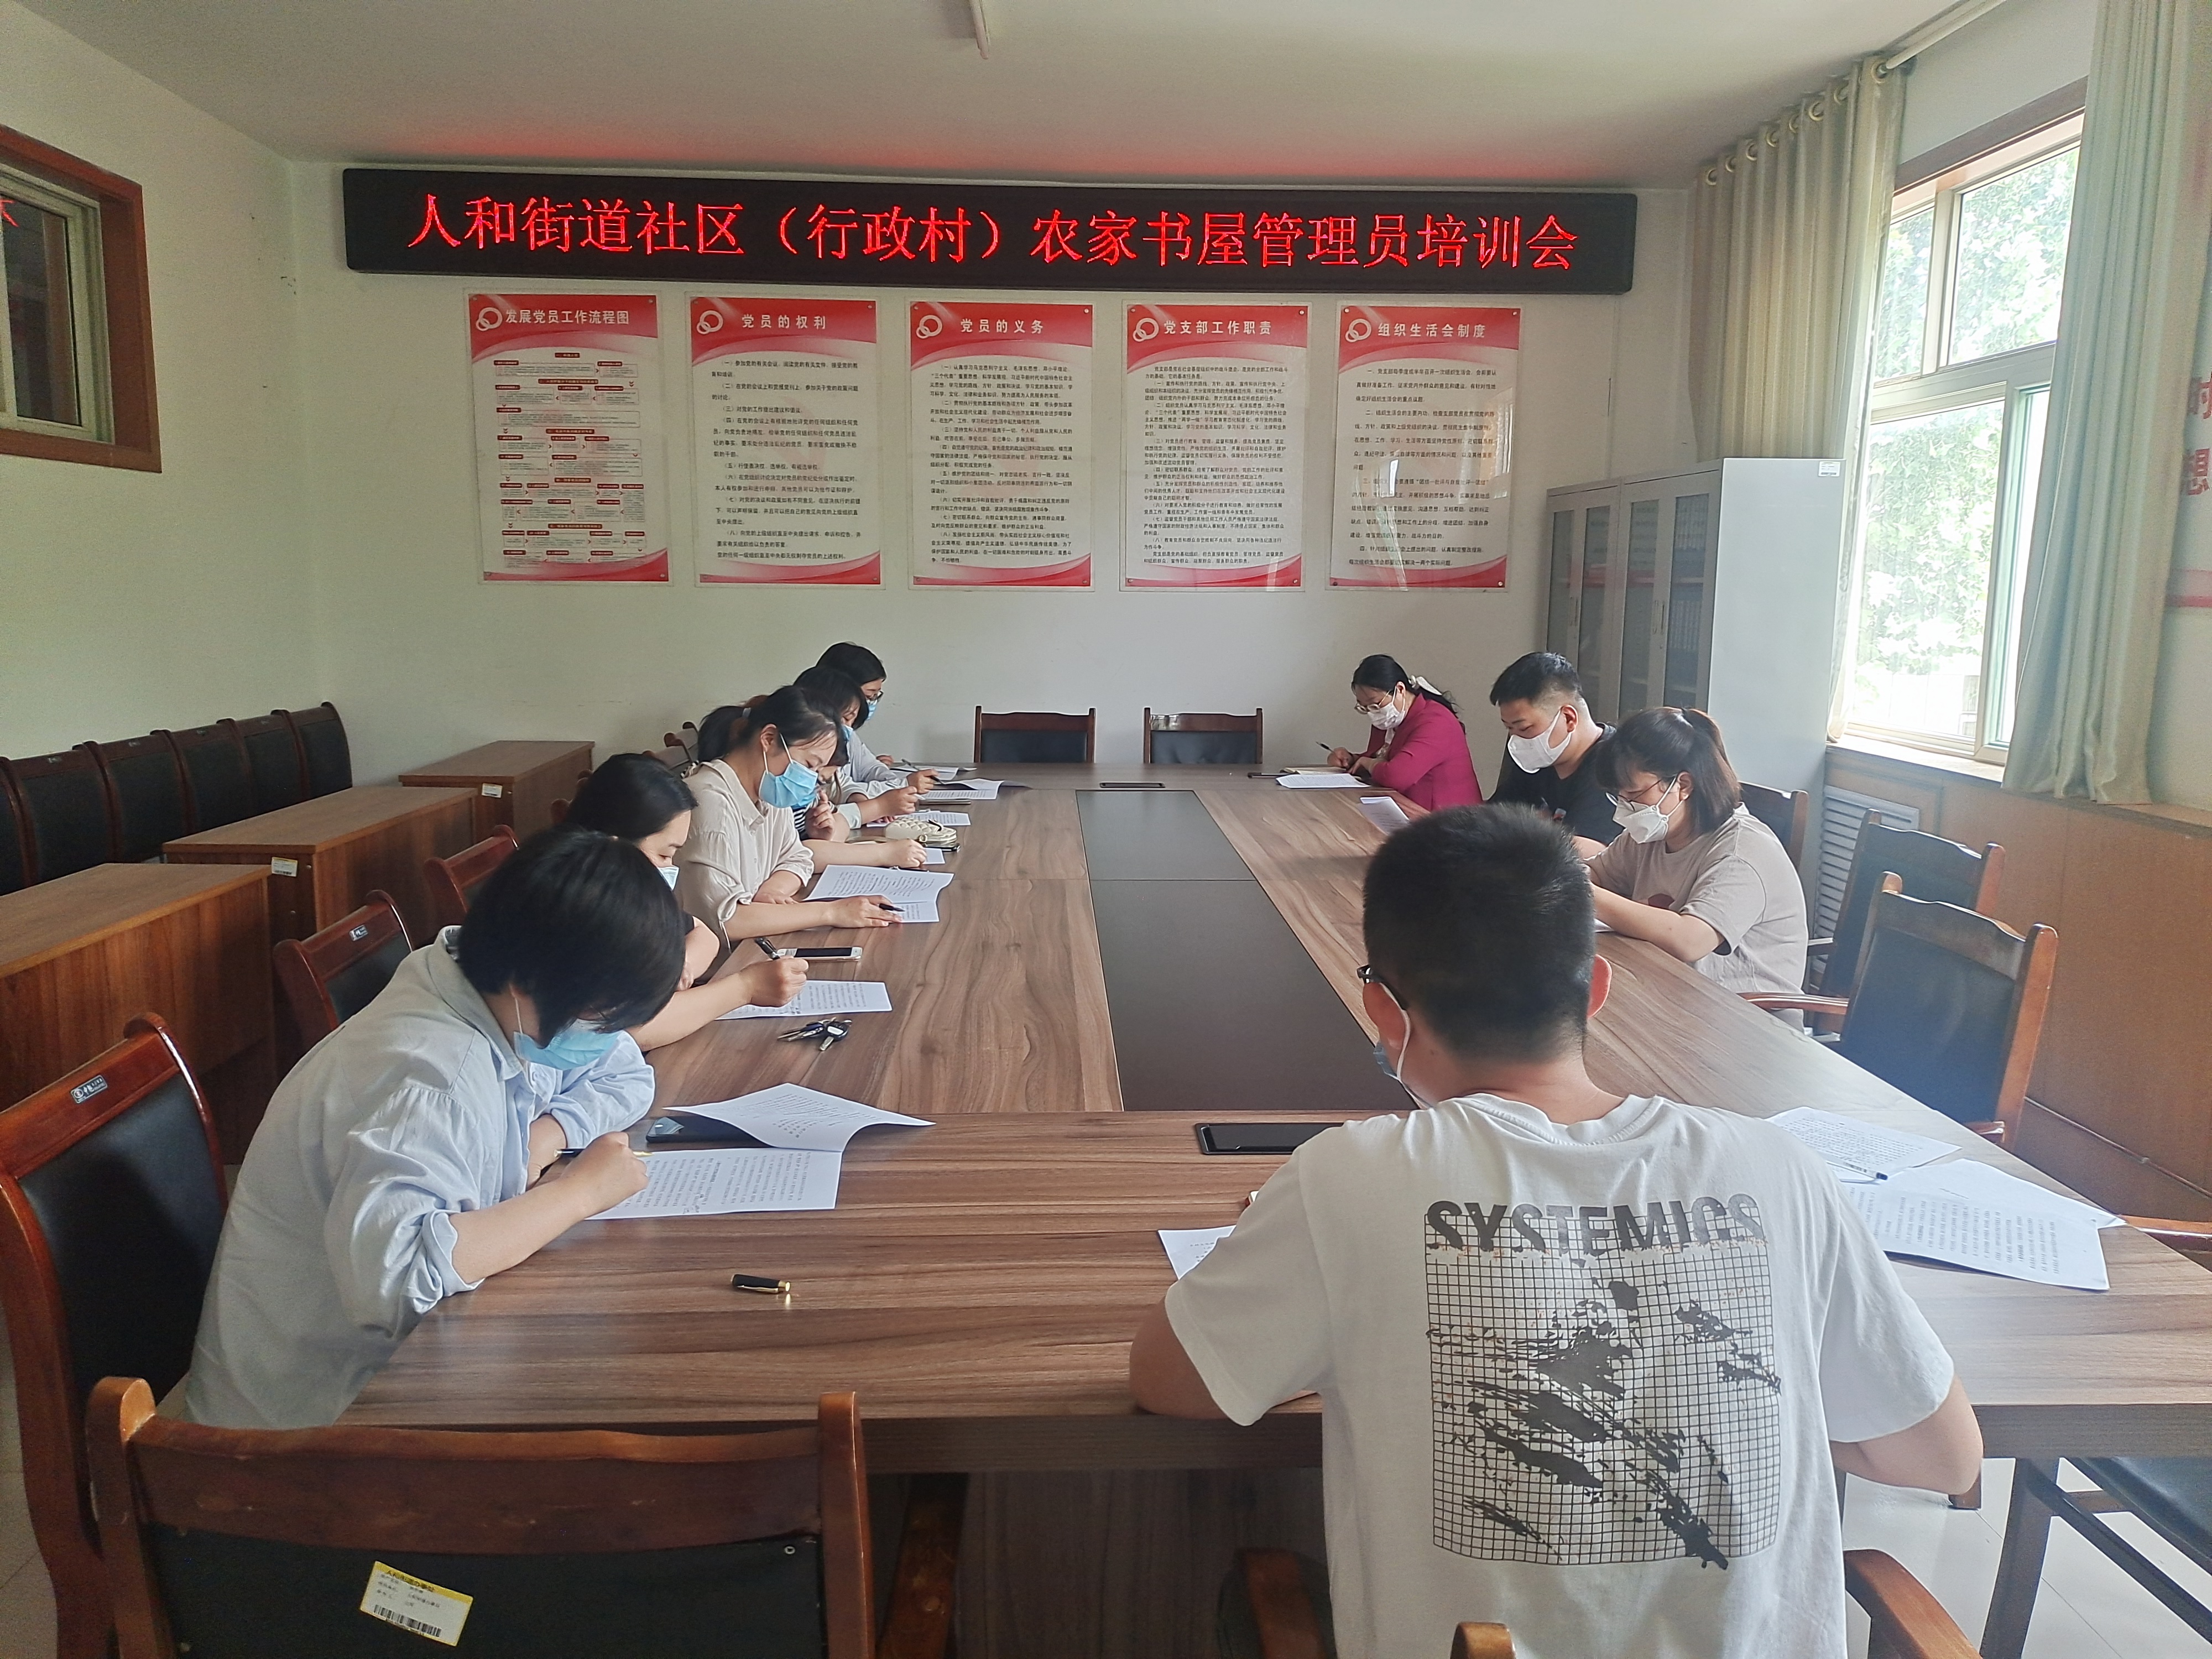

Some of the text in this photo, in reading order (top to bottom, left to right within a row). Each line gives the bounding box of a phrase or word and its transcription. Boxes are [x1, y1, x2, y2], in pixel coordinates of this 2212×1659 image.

[408, 194, 1577, 269] 人和街道社区（行政村）农家书屋管理员培训会
[505, 310, 629, 325] 发展党员工作流程图
[742, 314, 826, 330] 党员的权利
[961, 319, 1044, 334] 党员的义务
[1164, 321, 1271, 335] 党支部工作职责
[1378, 324, 1486, 338] 组织生活会制度
[1427, 1194, 1767, 1254] SYSTEMICS
